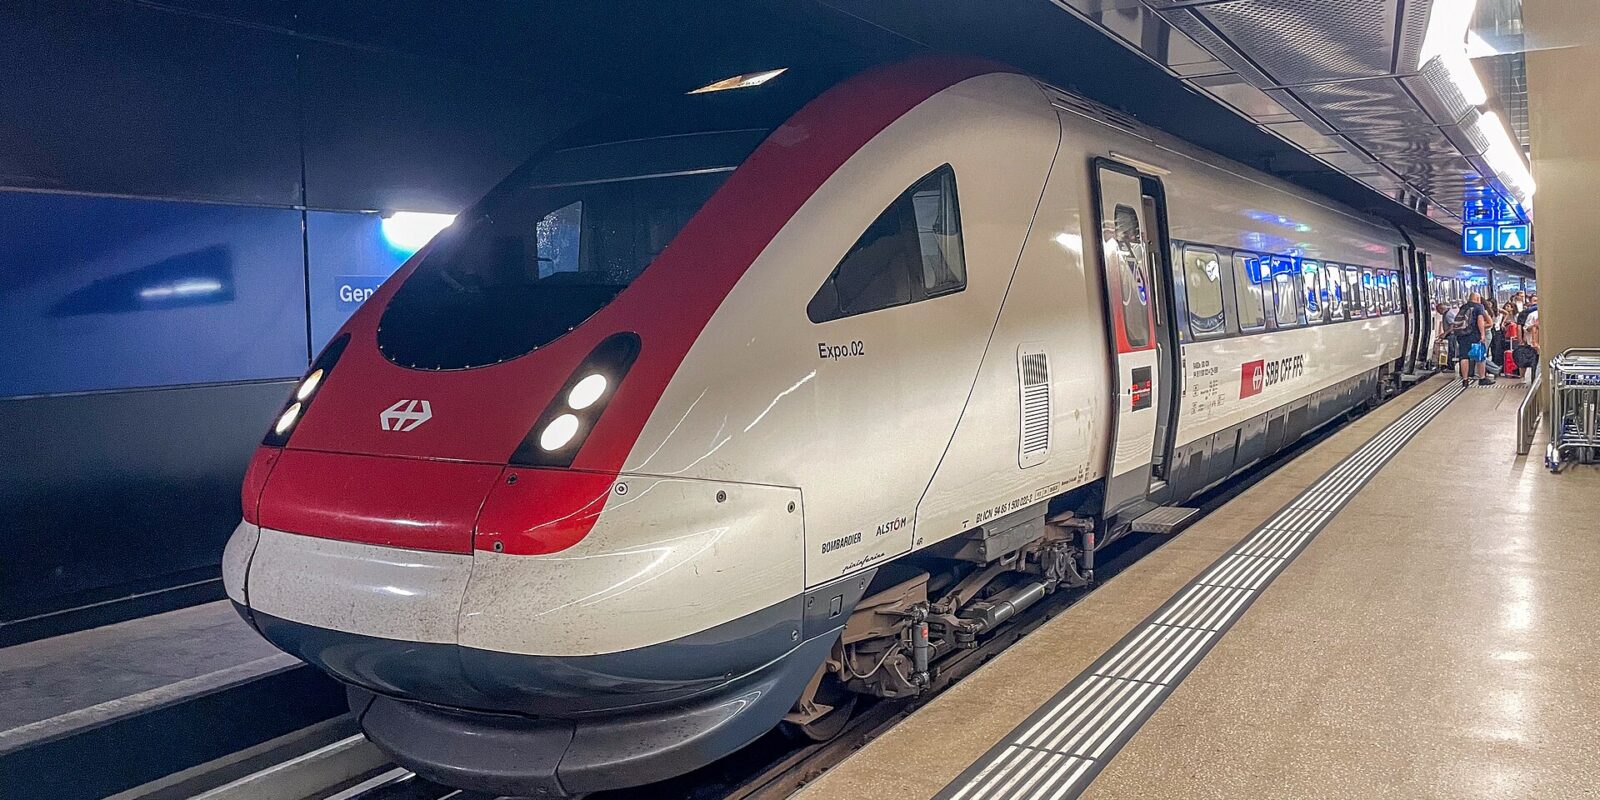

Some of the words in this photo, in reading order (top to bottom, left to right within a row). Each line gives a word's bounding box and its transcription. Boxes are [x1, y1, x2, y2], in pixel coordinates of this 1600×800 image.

[1473, 233, 1483, 250] 1
[1503, 230, 1522, 249] A
[339, 284, 374, 302] Gen
[817, 340, 865, 361] Expo.02
[1265, 360, 1280, 387] SBB
[1280, 357, 1293, 382] CFF
[1292, 354, 1304, 378] FFS
[875, 516, 907, 537] ALSTOM
[821, 532, 862, 554] BOMBARDIER
[841, 552, 886, 574] pininfarina
